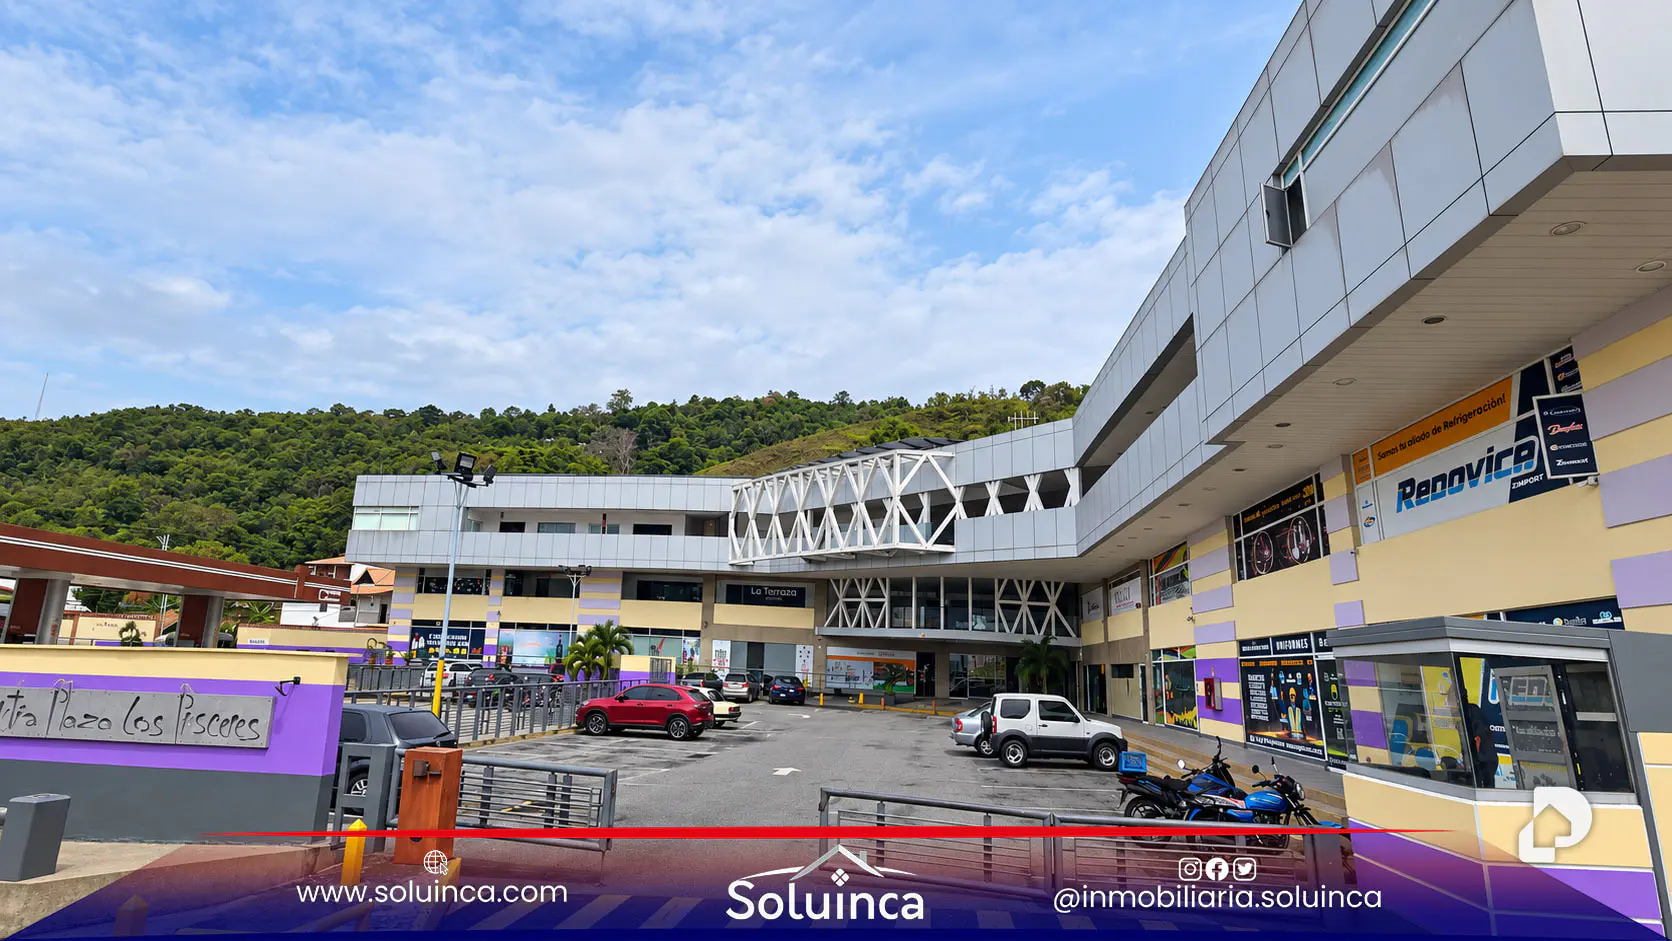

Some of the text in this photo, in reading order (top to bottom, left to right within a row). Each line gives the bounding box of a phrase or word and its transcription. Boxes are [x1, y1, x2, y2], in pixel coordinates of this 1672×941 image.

[1377, 393, 1507, 461] Somos tu aliado de Refrigeración!
[1396, 440, 1537, 513] Renovica
[751, 587, 797, 597] La Terraza
